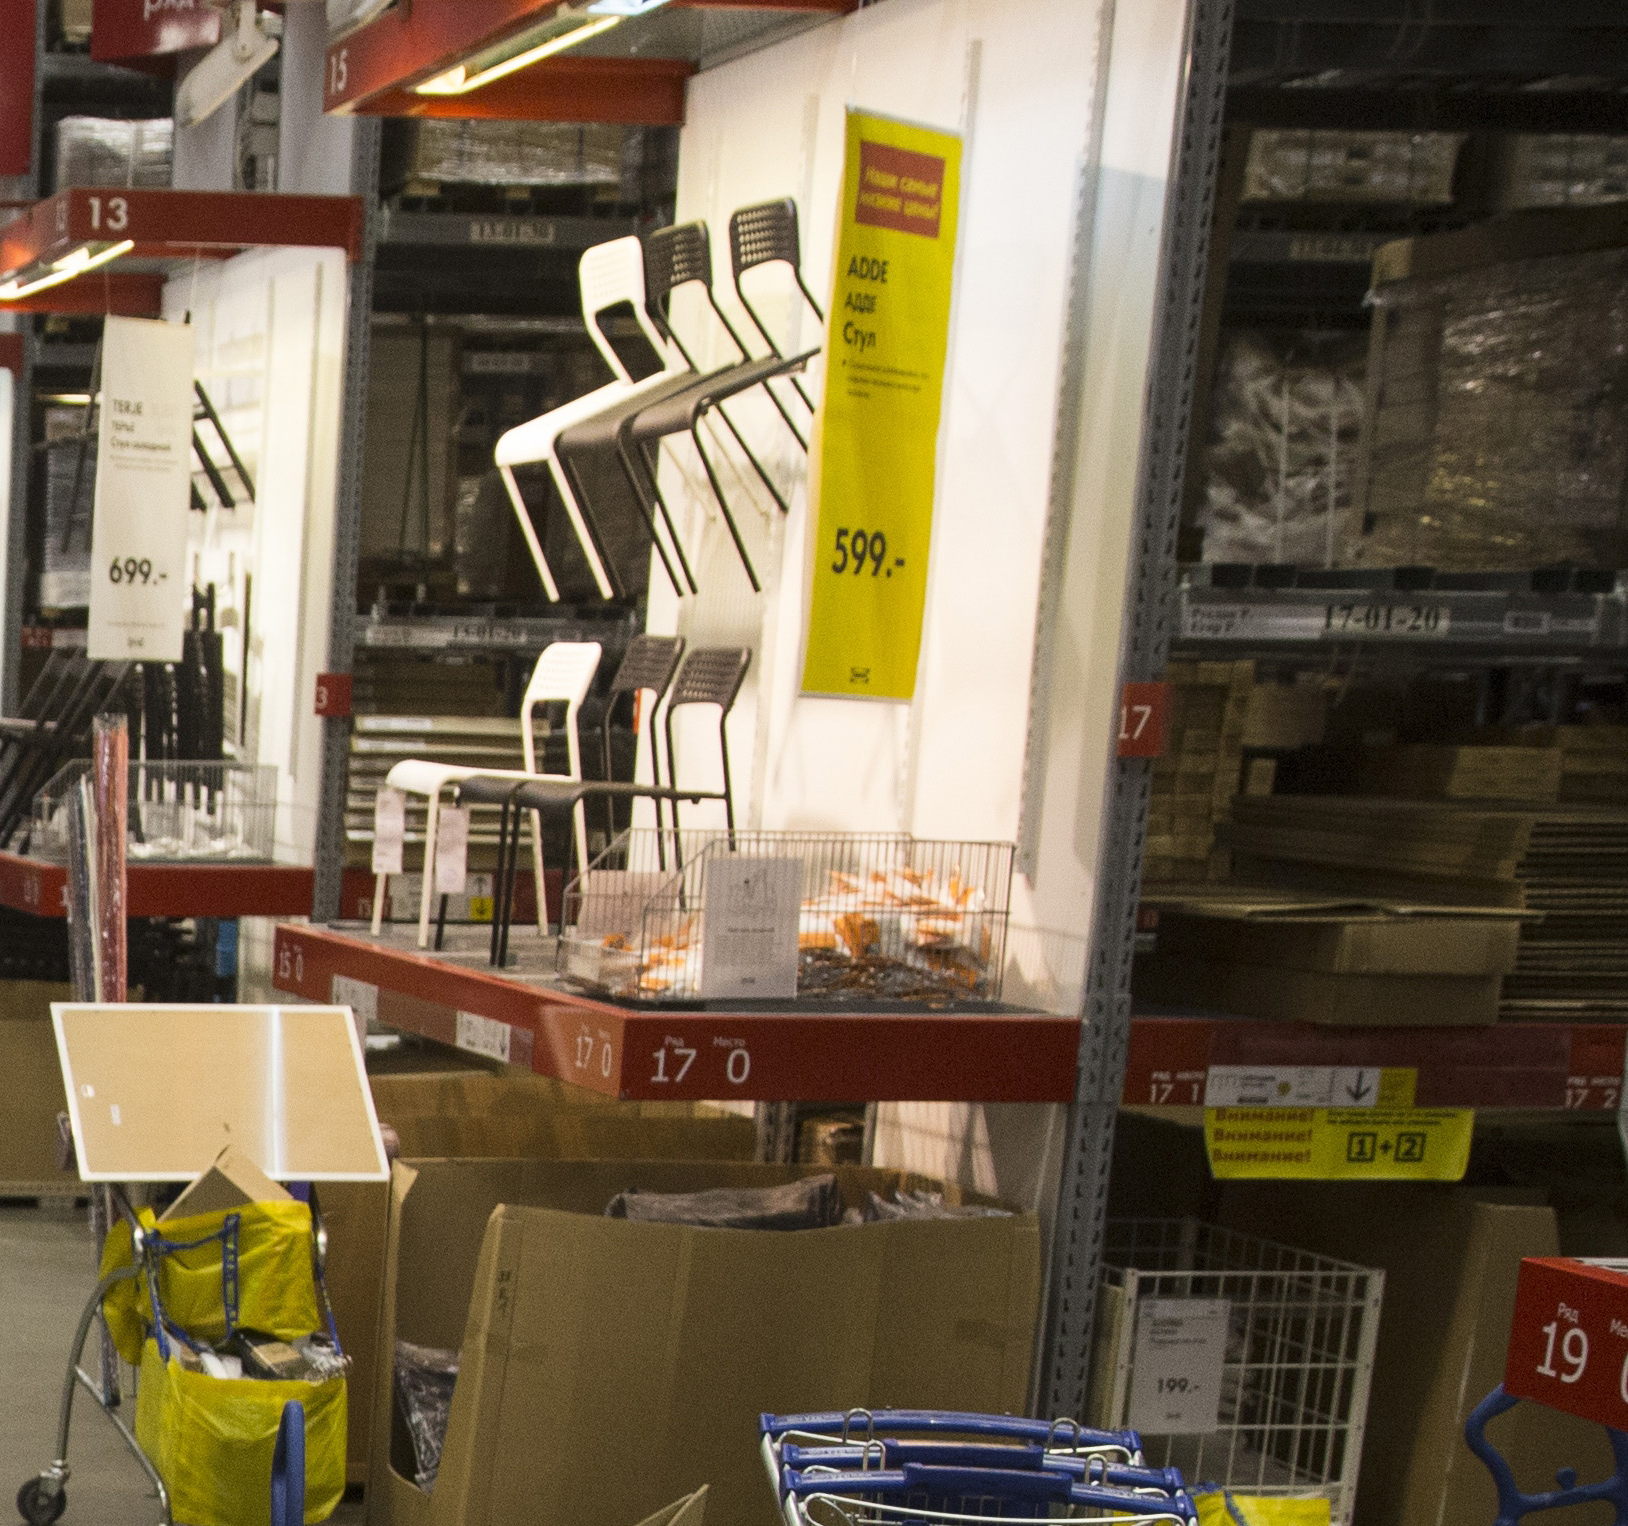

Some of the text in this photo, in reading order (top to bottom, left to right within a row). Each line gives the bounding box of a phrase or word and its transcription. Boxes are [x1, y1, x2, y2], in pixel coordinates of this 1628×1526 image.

[328, 51, 348, 93] 15
[88, 196, 129, 231] 13
[847, 254, 889, 283] ADDE
[843, 320, 877, 353] Стул
[832, 527, 905, 579] 599.-
[108, 555, 169, 586] 699.-
[1323, 606, 1441, 631] 17-01-20
[1118, 704, 1152, 742] 17
[573, 1035, 613, 1079] 17 0
[650, 1047, 752, 1085] 17 0
[1149, 1083, 1200, 1104] 17 1
[1565, 1088, 1620, 1109] 17 2
[1213, 1127, 1314, 1143] Внимание!
[1212, 1148, 1312, 1163] Внимание!
[1557, 1301, 1581, 1324] Ряд
[1535, 1321, 1590, 1384] 19
[1157, 1376, 1200, 1395] 199.-
